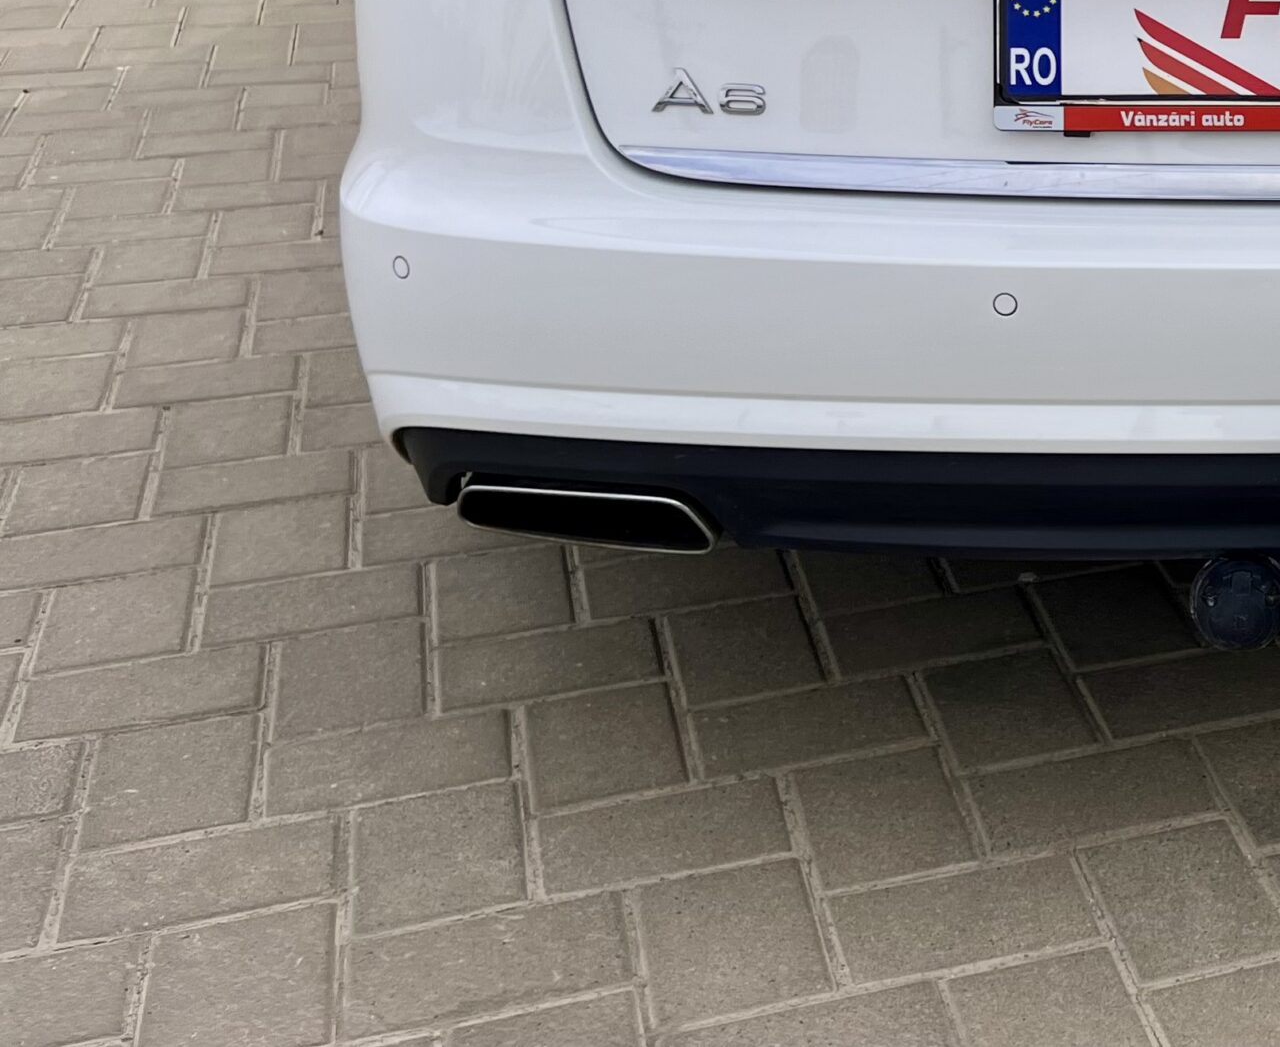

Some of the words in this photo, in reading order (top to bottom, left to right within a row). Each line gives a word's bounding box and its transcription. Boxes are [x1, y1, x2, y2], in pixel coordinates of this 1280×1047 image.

[1010, 47, 1057, 86] RO
[651, 67, 767, 116] A6
[1202, 111, 1245, 127] auto
